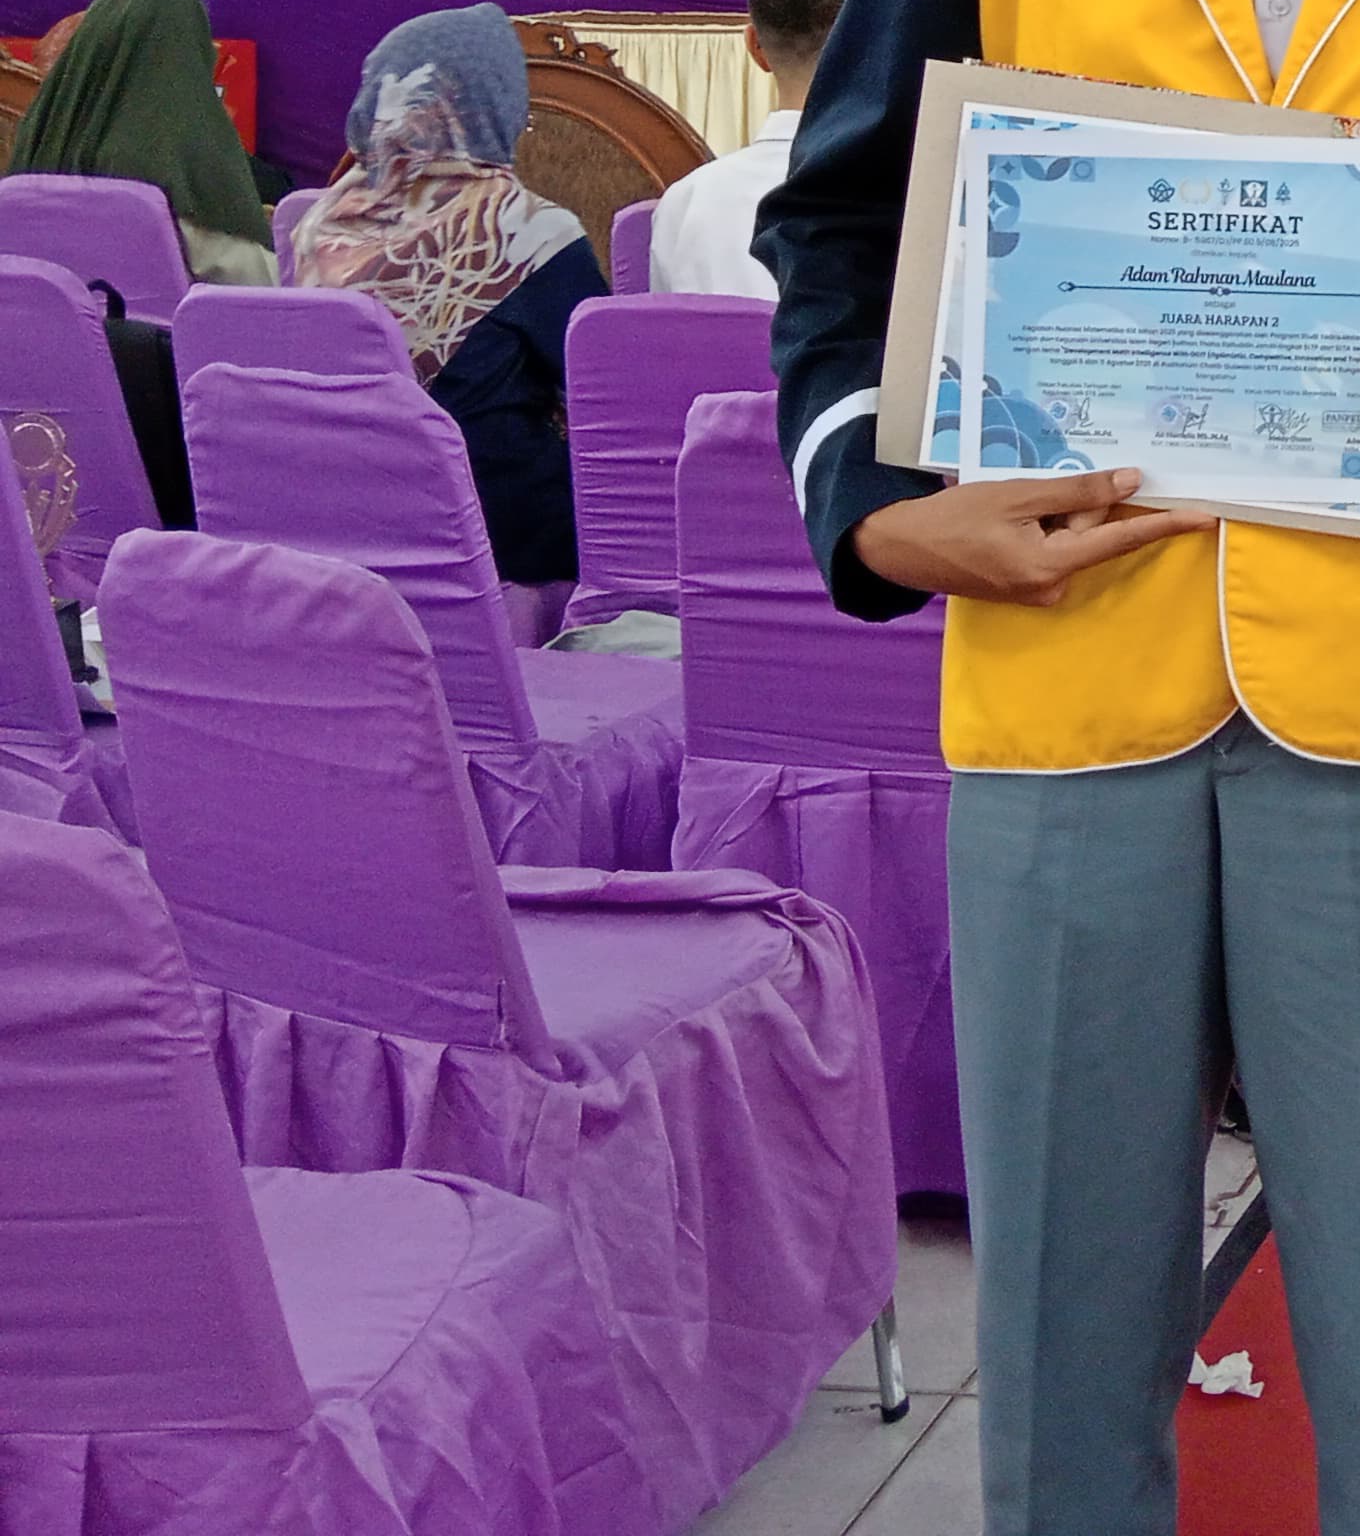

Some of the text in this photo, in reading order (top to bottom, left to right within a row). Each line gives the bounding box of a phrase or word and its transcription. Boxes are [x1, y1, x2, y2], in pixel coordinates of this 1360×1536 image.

[1148, 211, 1304, 234] SERTIFIKAT
[1120, 265, 1317, 288] Adam Rahman Maulana
[1160, 314, 1280, 327] JUARA HARAPAN 2
